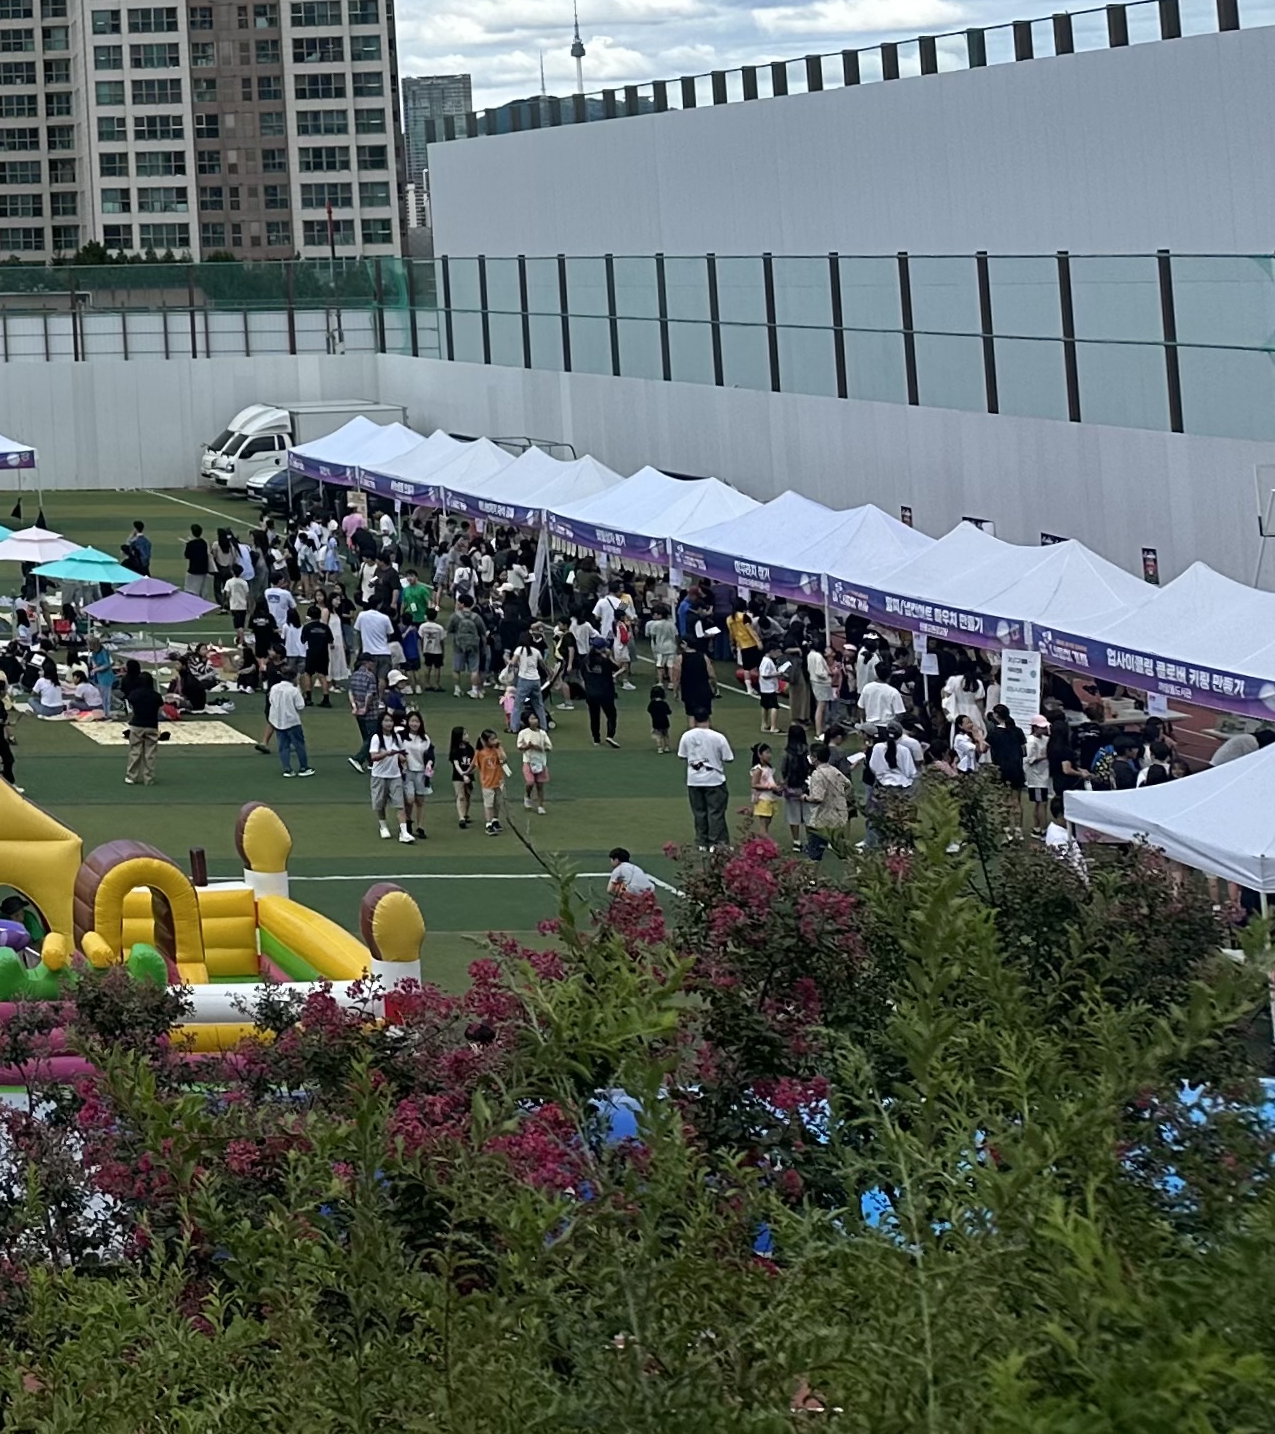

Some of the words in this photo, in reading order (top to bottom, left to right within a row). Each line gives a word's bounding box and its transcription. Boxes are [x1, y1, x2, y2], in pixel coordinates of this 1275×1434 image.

[959, 613, 984, 634] 만들기
[1106, 647, 1154, 677] 업사이클링
[1155, 660, 1187, 685] 클로버
[1189, 668, 1210, 691] 키링
[1212, 673, 1246, 699] 만들기
